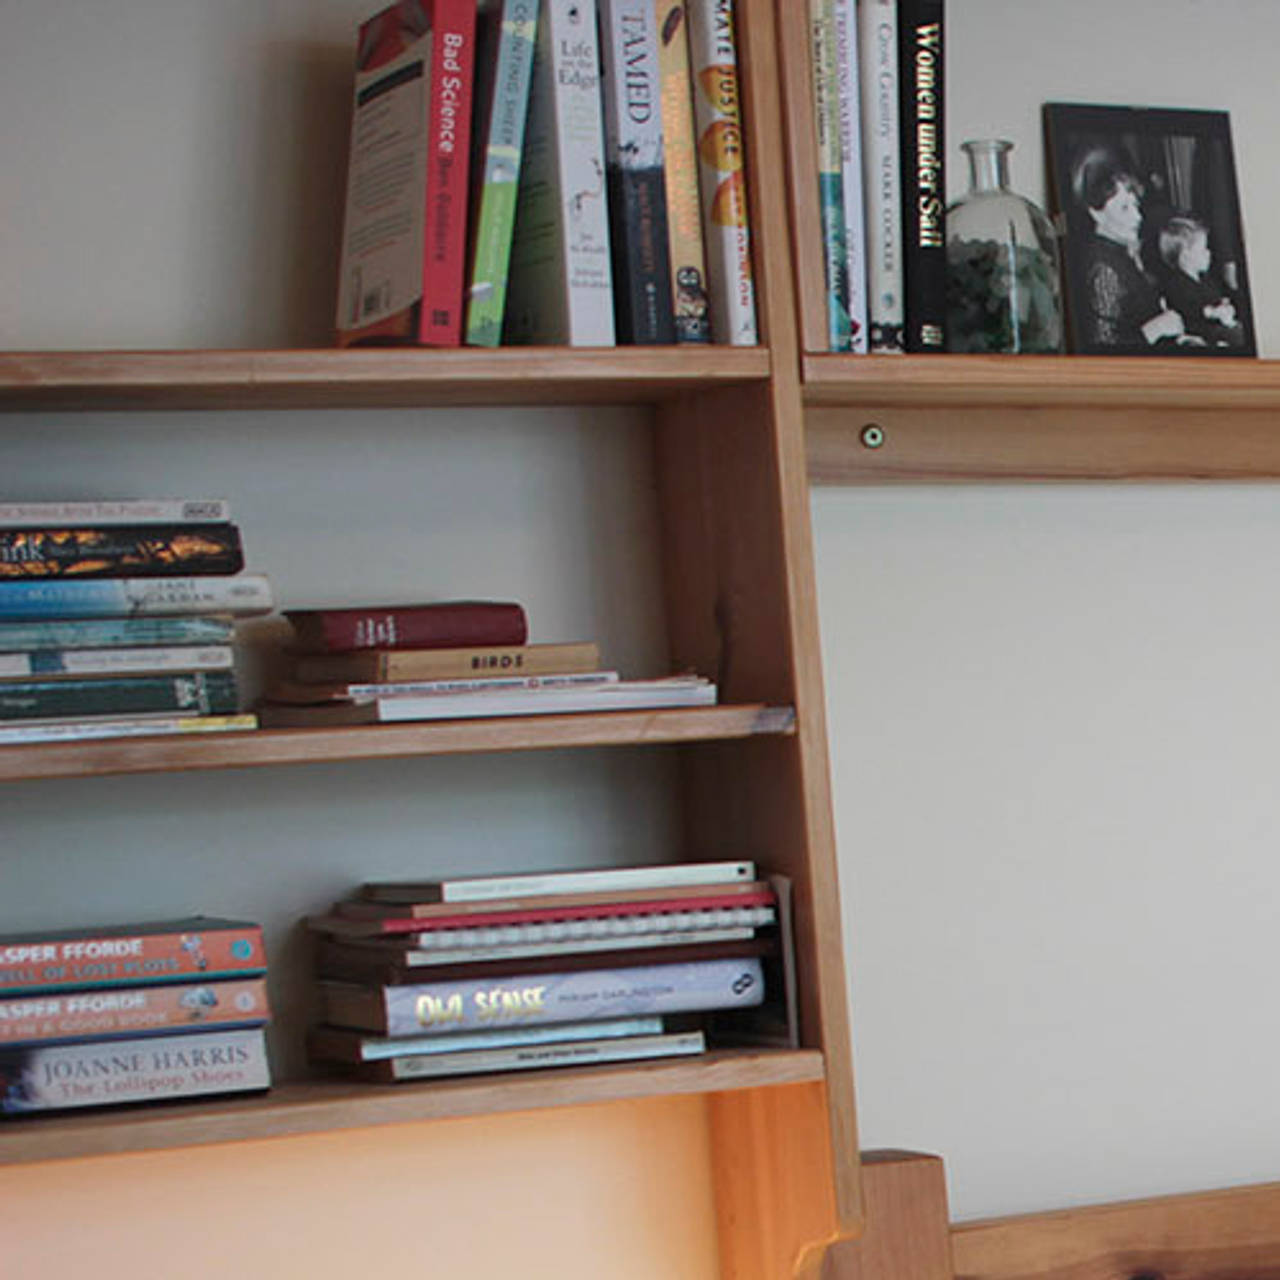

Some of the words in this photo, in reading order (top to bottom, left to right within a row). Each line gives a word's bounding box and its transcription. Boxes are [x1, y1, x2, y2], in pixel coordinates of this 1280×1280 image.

[443, 33, 463, 72] Bad
[621, 8, 652, 124] TAMED
[915, 23, 940, 119] Women
[438, 76, 462, 153] Science
[718, 67, 740, 154] JUSTICE
[916, 121, 942, 194] under
[918, 196, 943, 248] Sail
[63, 938, 144, 961] FFORDE
[67, 993, 146, 1014] FFORDE
[473, 985, 548, 1021] SENSE
[43, 1054, 145, 1086] JOANNE
[152, 1045, 249, 1070] HARRIS
